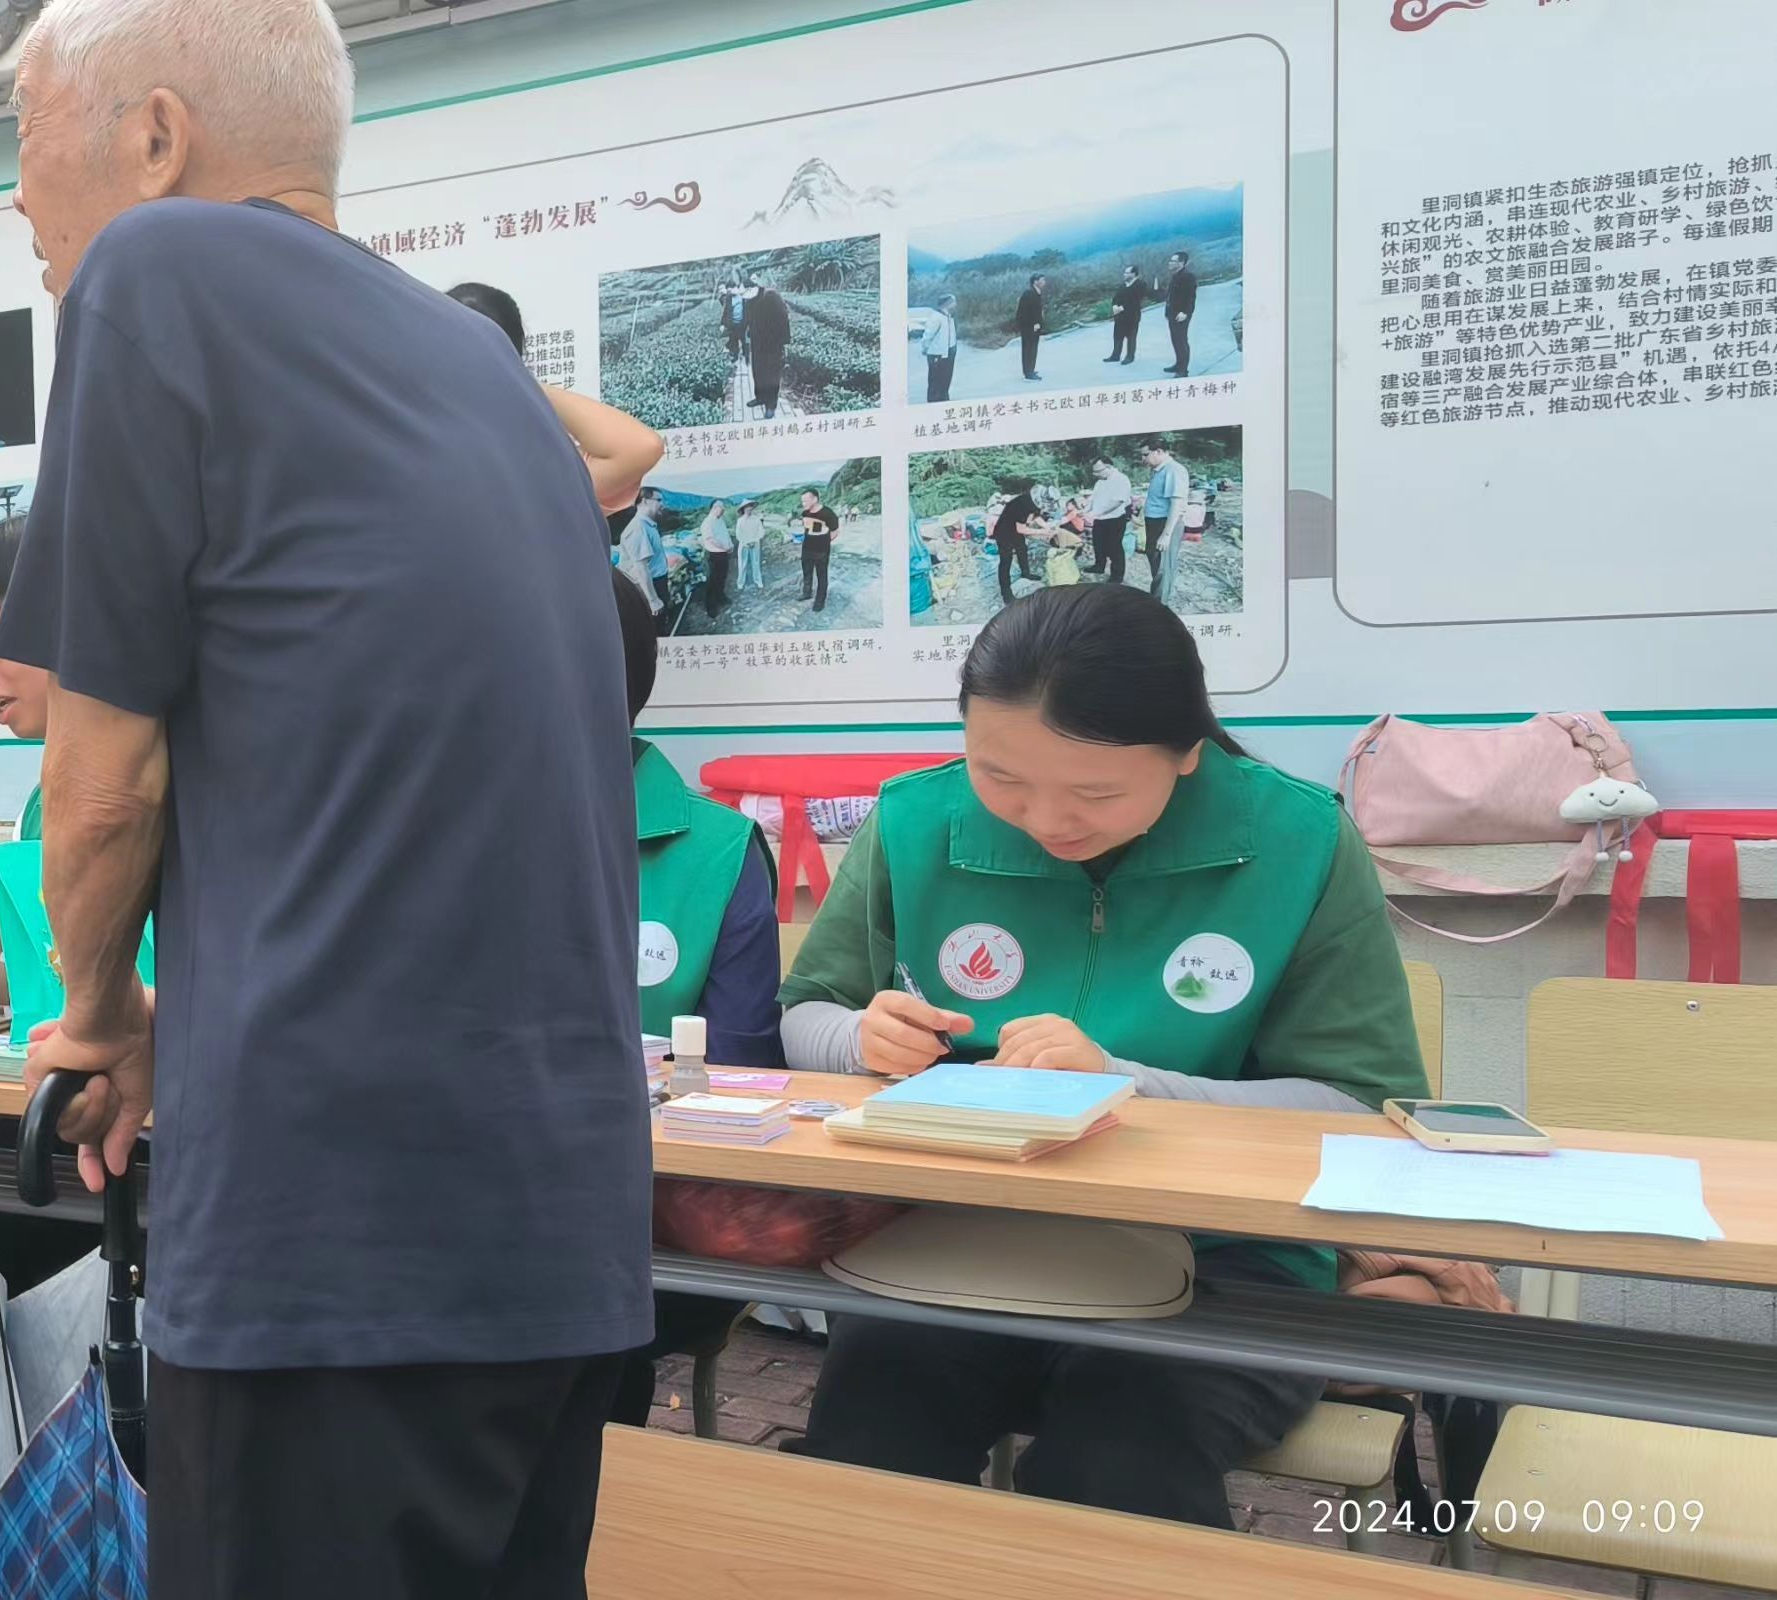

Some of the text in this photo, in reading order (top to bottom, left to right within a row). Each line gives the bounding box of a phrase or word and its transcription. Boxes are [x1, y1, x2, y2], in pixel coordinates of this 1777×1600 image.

[1381, 175, 1777, 239] 和文化内涵，串连现代农业、乡村旅游、
[1422, 153, 1777, 214] 里洞镇紧扣生态旅游强镇定位，抢抓
[355, 197, 609, 258] 镇域经济“蓬勃发展”
[1381, 194, 1777, 257] 休闲观光、农耕体验、教育研学、绿色饮
[1421, 318, 1777, 368] 里洞镇抢抓入选第二批广东省乡村旅
[1381, 359, 1777, 410] 宿等三产融合发展产业综合体，串联红色
[1381, 380, 1777, 428] 等红色旅游节点，推动现代农业、乡村旅
[663, 416, 877, 447] 党委书记欧国华到石村调研五
